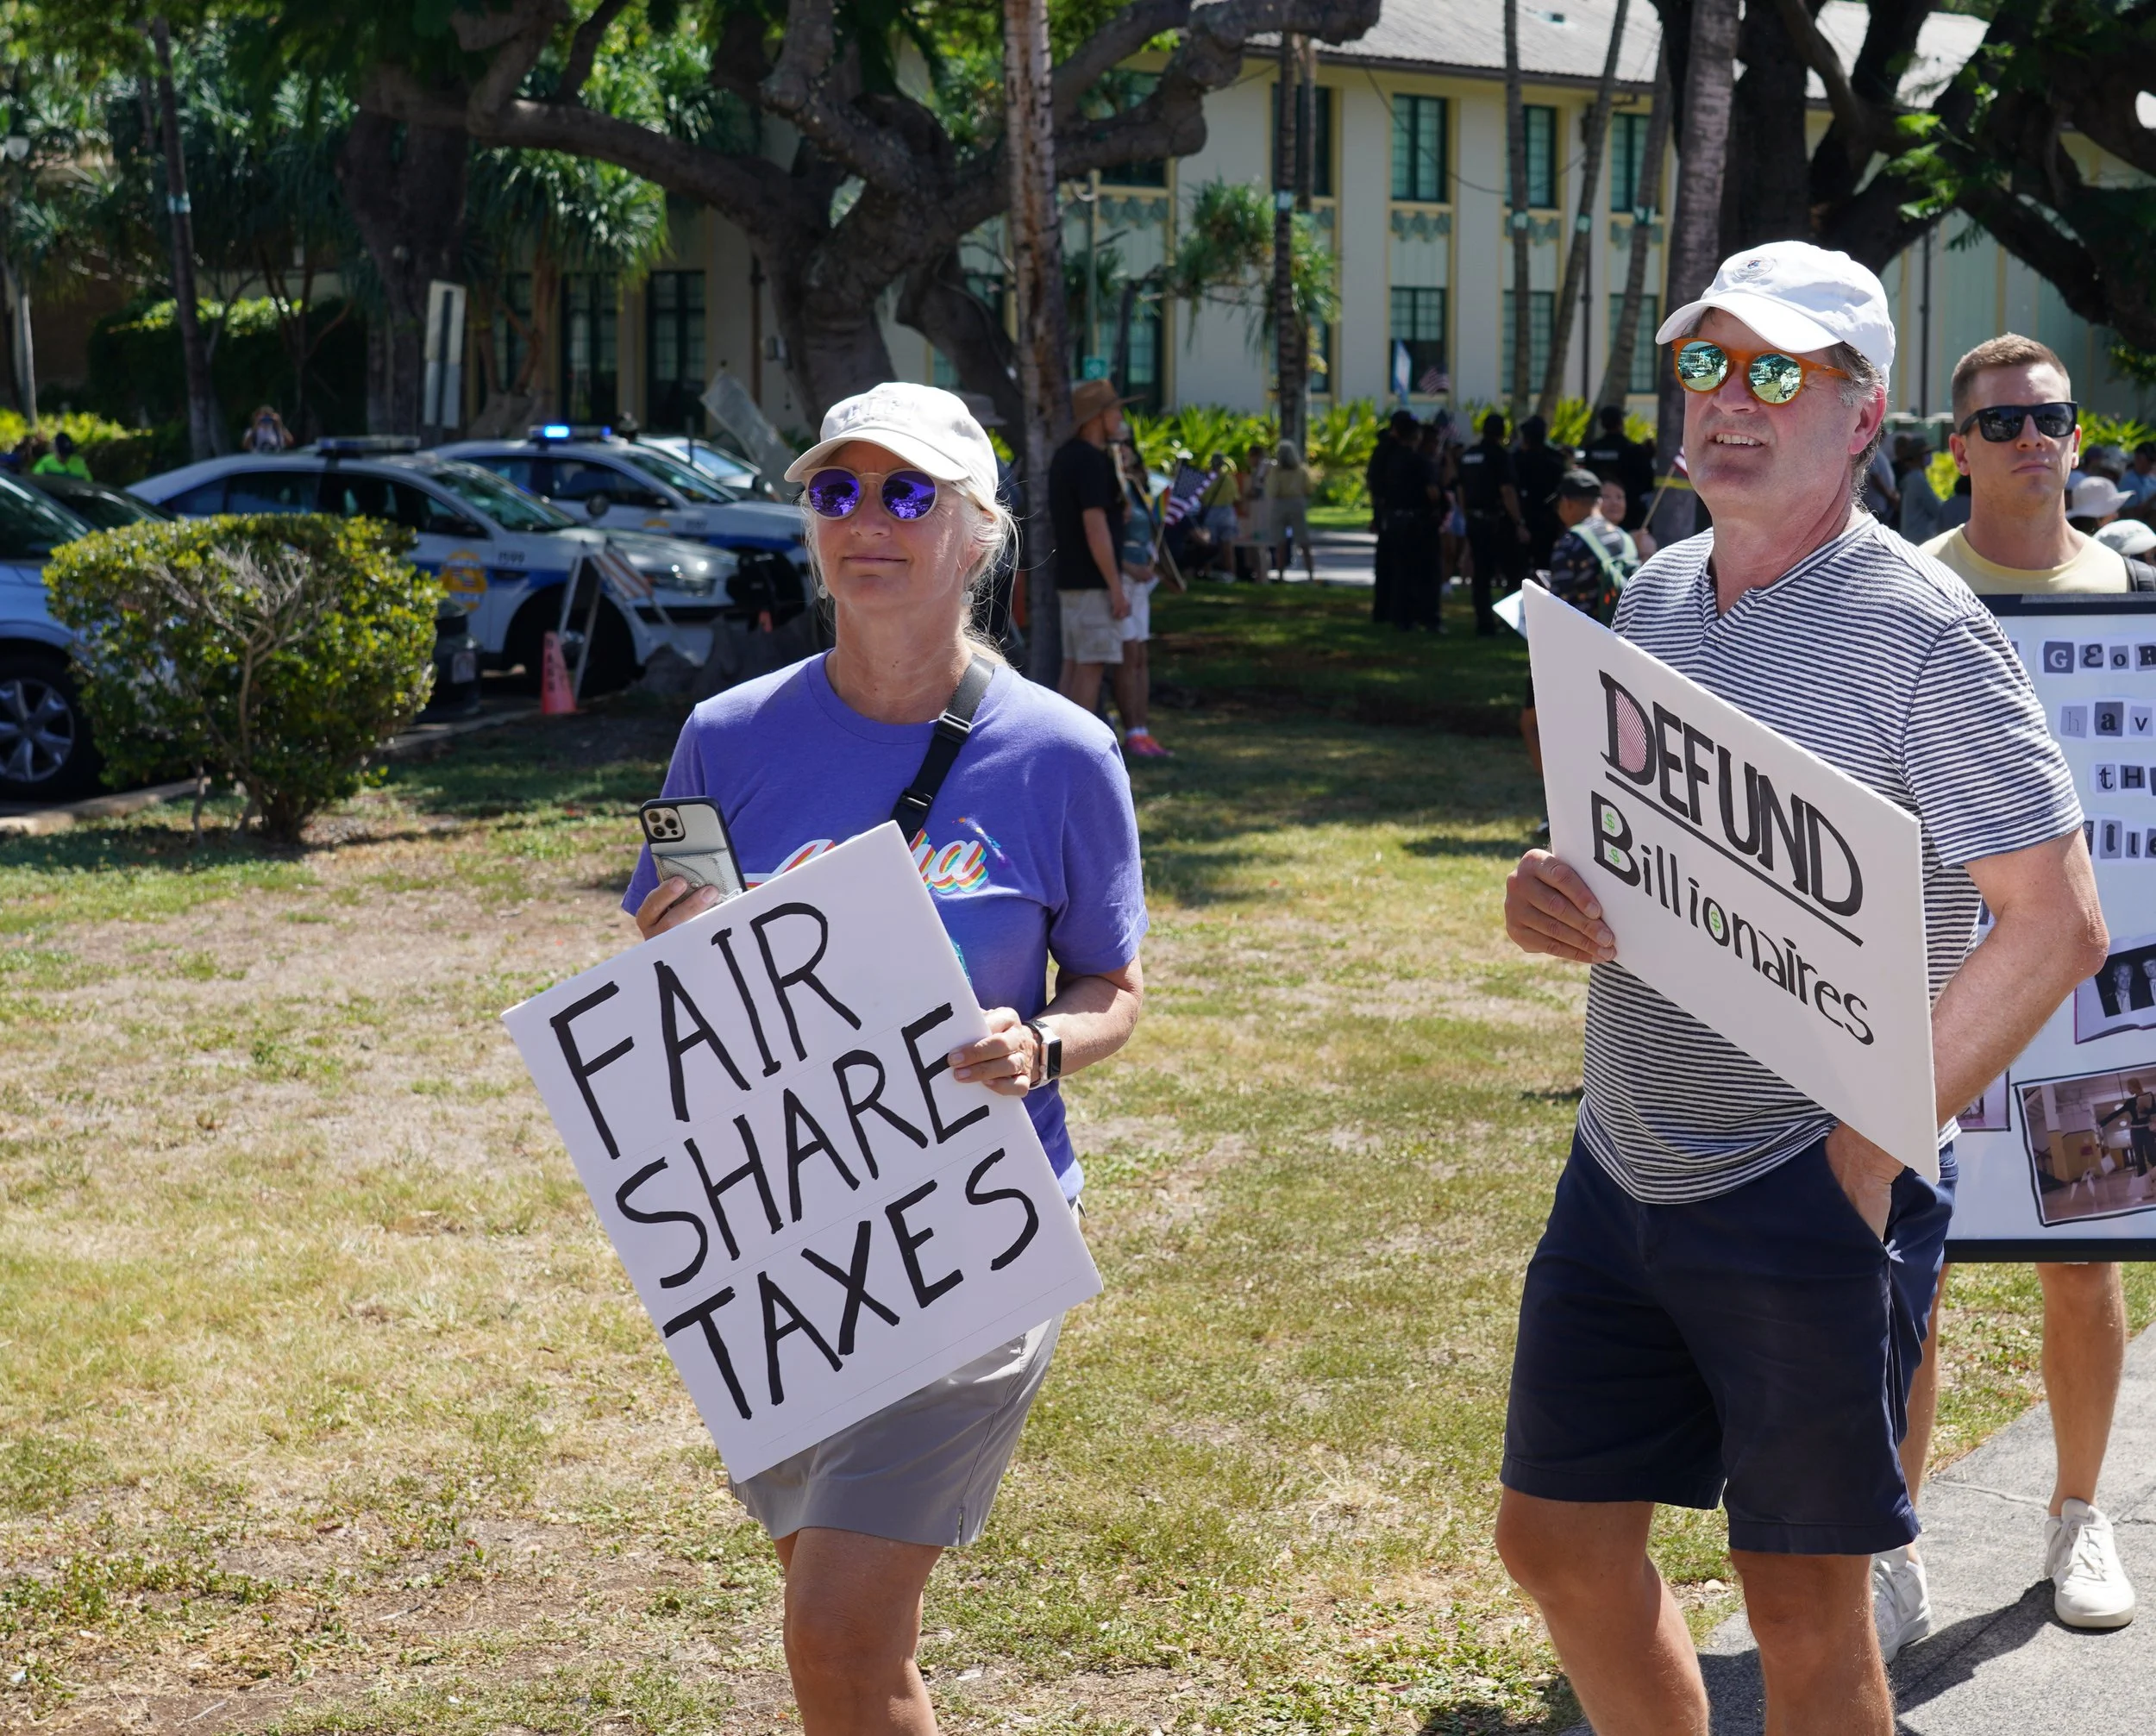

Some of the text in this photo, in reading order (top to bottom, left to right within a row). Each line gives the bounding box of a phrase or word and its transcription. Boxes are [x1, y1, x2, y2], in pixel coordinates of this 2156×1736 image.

[1598, 668, 1865, 917] DEFUND
[2098, 766, 2156, 790] tH
[550, 902, 862, 1159] FAIR
[1590, 790, 1875, 1045] Billionaires
[615, 1002, 990, 1288] SHARE
[663, 1148, 1039, 1420] TAXES
